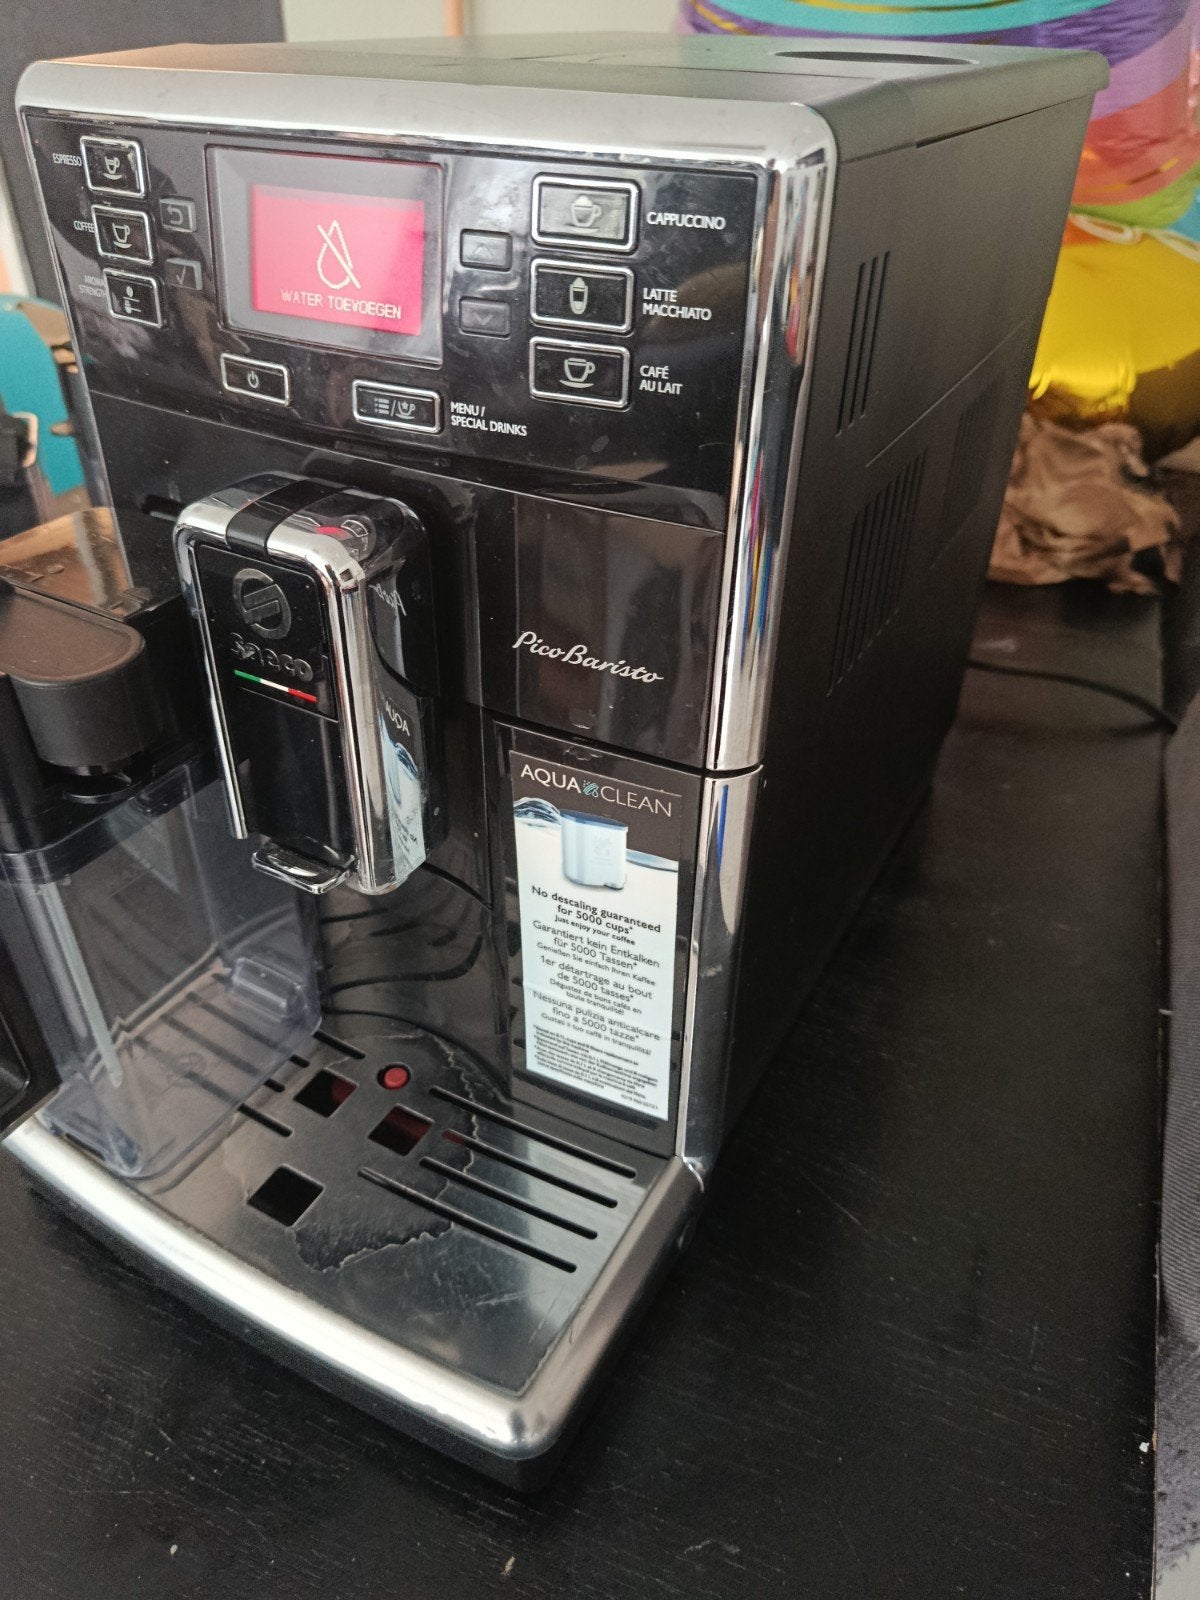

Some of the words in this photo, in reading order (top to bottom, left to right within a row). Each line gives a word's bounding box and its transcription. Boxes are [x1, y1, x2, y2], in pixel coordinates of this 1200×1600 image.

[53, 153, 82, 167] ESPRESSO
[74, 220, 96, 233] COFFEE
[646, 212, 726, 230] CAPPUCCINO
[281, 288, 323, 307] WATER
[328, 295, 401, 319] TOEVOEGEN
[643, 288, 678, 302] LATTE
[643, 303, 712, 321] MACCHIATO
[640, 365, 669, 379] CAFÉ
[639, 380, 656, 392] AU
[658, 381, 683, 395] LAIT
[450, 401, 480, 416] MENU
[451, 415, 488, 431] SPECIAL
[489, 421, 527, 437] DRINKS
[512, 631, 664, 683] PicoBaristo
[521, 764, 581, 794] AQUA
[600, 786, 672, 817] CLEAN
[532, 885, 548, 898] No
[552, 892, 598, 916] descaling
[601, 909, 661, 932] guaranteed
[557, 904, 572, 916] for
[576, 910, 602, 925] 5000
[555, 915, 569, 925] Just
[571, 921, 591, 932] enjoy
[592, 928, 610, 938] your
[612, 934, 635, 945] coffee
[532, 920, 584, 943] Garantiert
[586, 938, 607, 951] kein
[610, 945, 660, 968] Entkalken
[553, 937, 568, 948] für
[571, 943, 597, 958] 5000
[540, 955, 556, 966] 1er
[558, 962, 610, 986] détartrage
[613, 981, 625, 990] au
[628, 985, 653, 999] bout
[557, 971, 569, 982] de
[572, 976, 598, 991] 5000
[533, 990, 573, 1011] Nessuna
[575, 1007, 605, 1022] pulizia
[608, 1018, 661, 1041] anticalcare
[552, 1007, 571, 1019] fino
[582, 1018, 607, 1032] 5000
